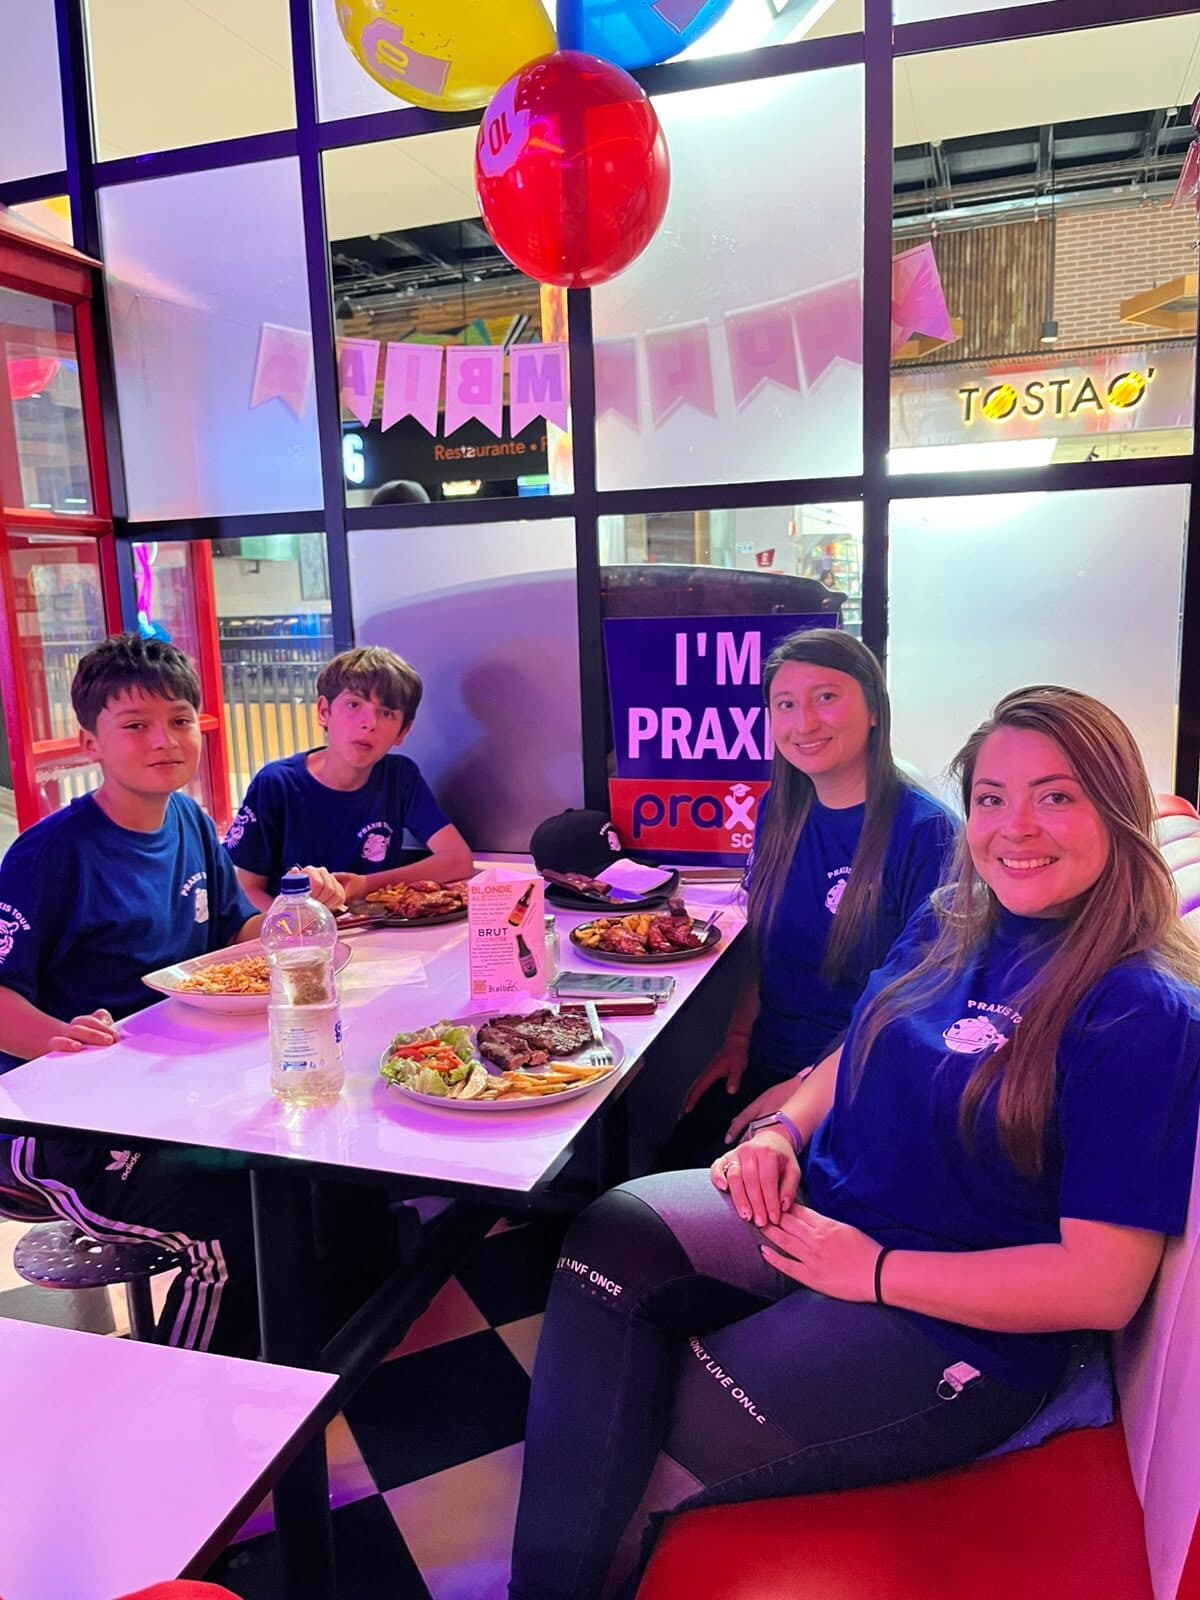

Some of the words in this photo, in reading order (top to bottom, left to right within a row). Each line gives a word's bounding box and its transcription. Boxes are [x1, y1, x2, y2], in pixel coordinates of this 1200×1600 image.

[434, 442, 526, 461] Restaurante
[675, 631, 762, 686] I'M
[471, 884, 513, 895] BLONDE
[12, 907, 31, 931] TOUR
[477, 927, 508, 937] BRUT
[967, 999, 1013, 1017] PRAXIS
[589, 1270, 623, 1297] ONCE
[705, 1360, 735, 1389] LIVE
[731, 1387, 767, 1425] ONCE
